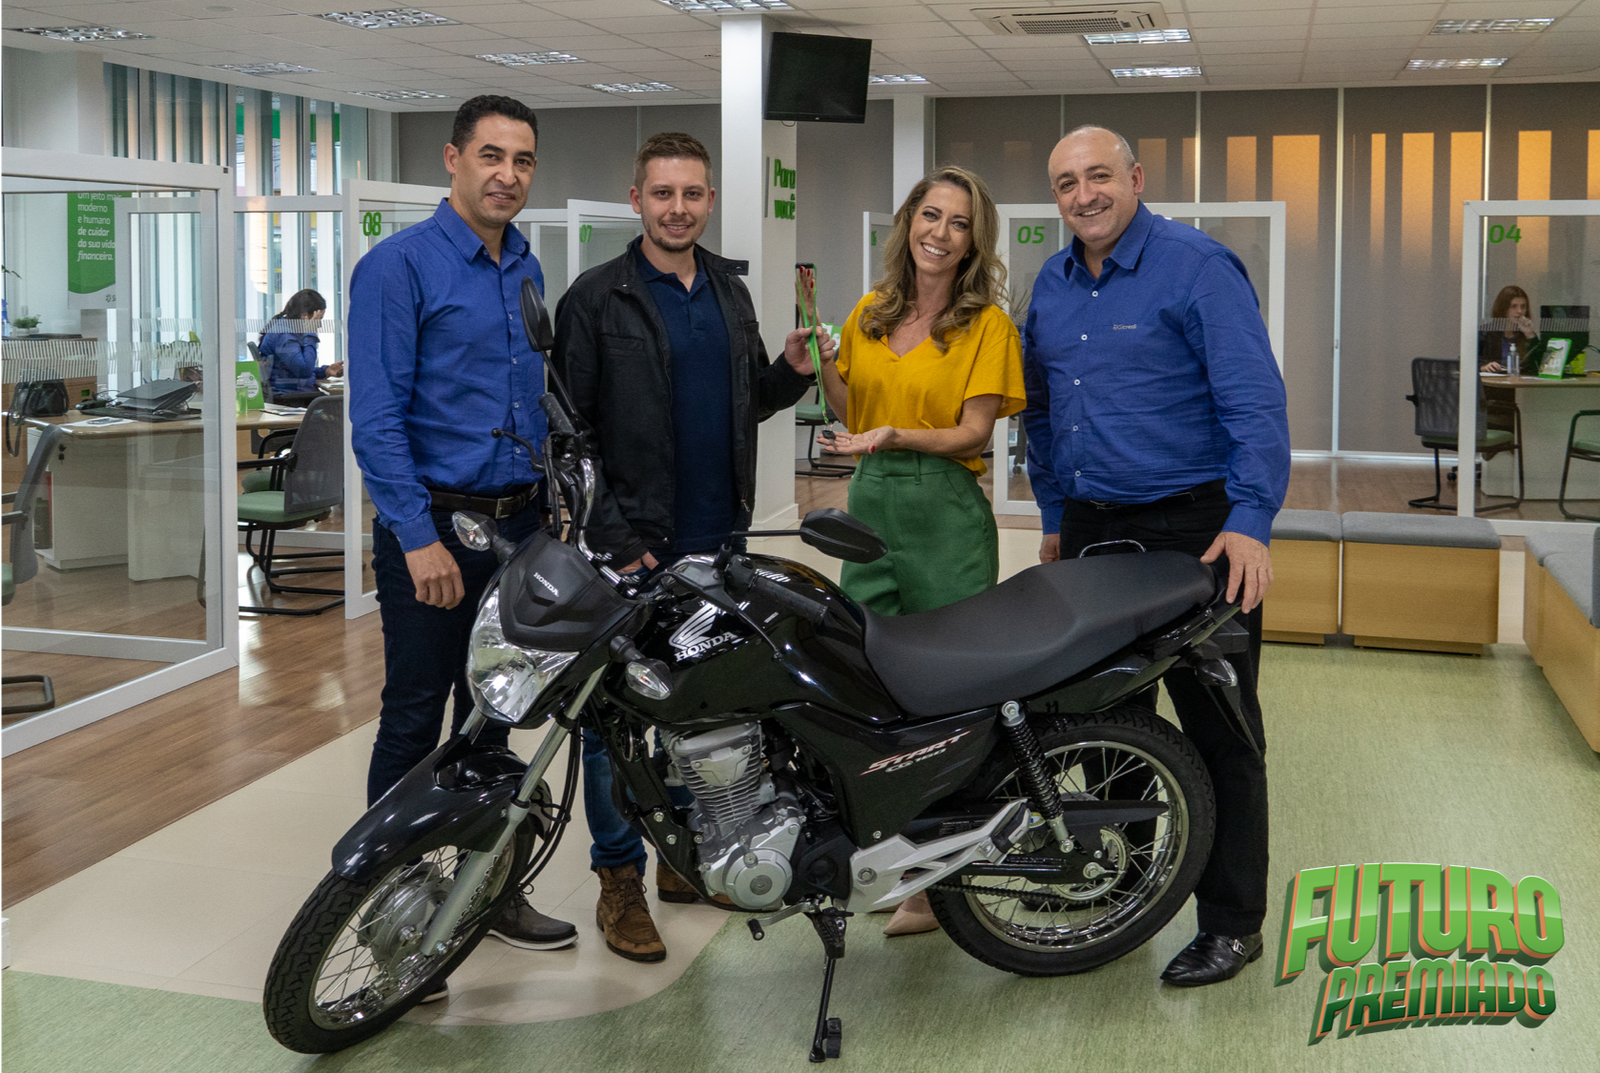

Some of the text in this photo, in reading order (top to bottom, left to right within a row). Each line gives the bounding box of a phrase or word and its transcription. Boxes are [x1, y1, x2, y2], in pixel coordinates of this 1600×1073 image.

[774, 158, 796, 190] Para
[78, 203, 108, 213] moderno
[774, 193, 796, 219] você
[83, 214, 111, 225] humano
[363, 211, 382, 236] 08
[78, 226, 110, 237] de cuidar
[580, 224, 592, 243] 07
[1017, 225, 1046, 244] 05
[1489, 224, 1522, 244] 04
[78, 238, 116, 249] da sua vida
[77, 250, 114, 262] financeira.
[533, 571, 560, 598] HONDA
[674, 631, 738, 662] HONDA
[860, 730, 972, 776] START
[885, 759, 914, 773] CG
